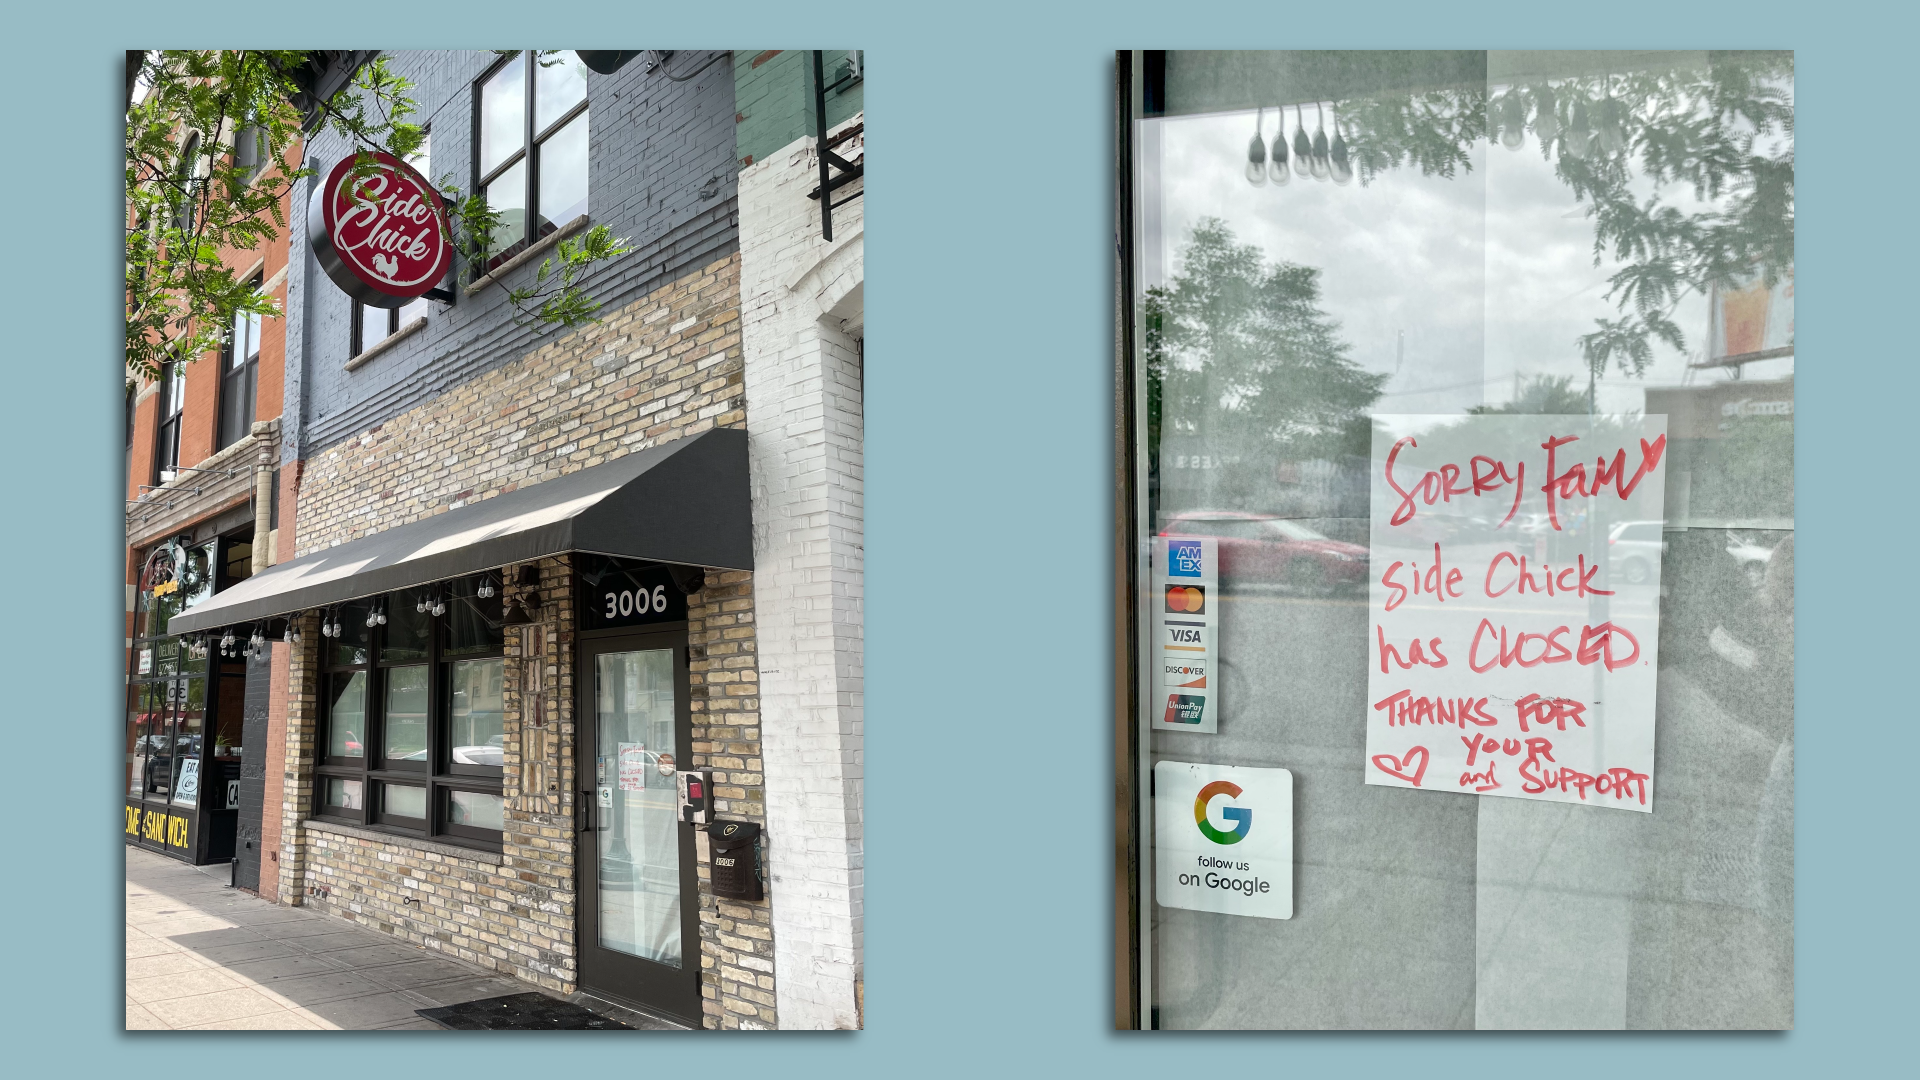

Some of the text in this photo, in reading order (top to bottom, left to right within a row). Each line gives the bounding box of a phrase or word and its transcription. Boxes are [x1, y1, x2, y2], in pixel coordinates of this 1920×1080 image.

[351, 173, 432, 226] Side
[333, 204, 431, 262] Chick
[1177, 546, 1202, 560] AM
[1180, 558, 1202, 572] EX
[1483, 550, 1616, 599] Chick
[605, 584, 667, 619] 3006
[1168, 628, 1202, 643] VISA
[1377, 623, 1449, 674] has
[1165, 665, 1205, 676] DISCOVER
[1168, 700, 1203, 714] UnionPay
[1374, 688, 1587, 732] THANKS FOR
[1460, 732, 1556, 766] YOUR
[1459, 756, 1650, 806] and SUPPORT
[1197, 855, 1250, 871] follow us
[1178, 872, 1270, 897] on Google
